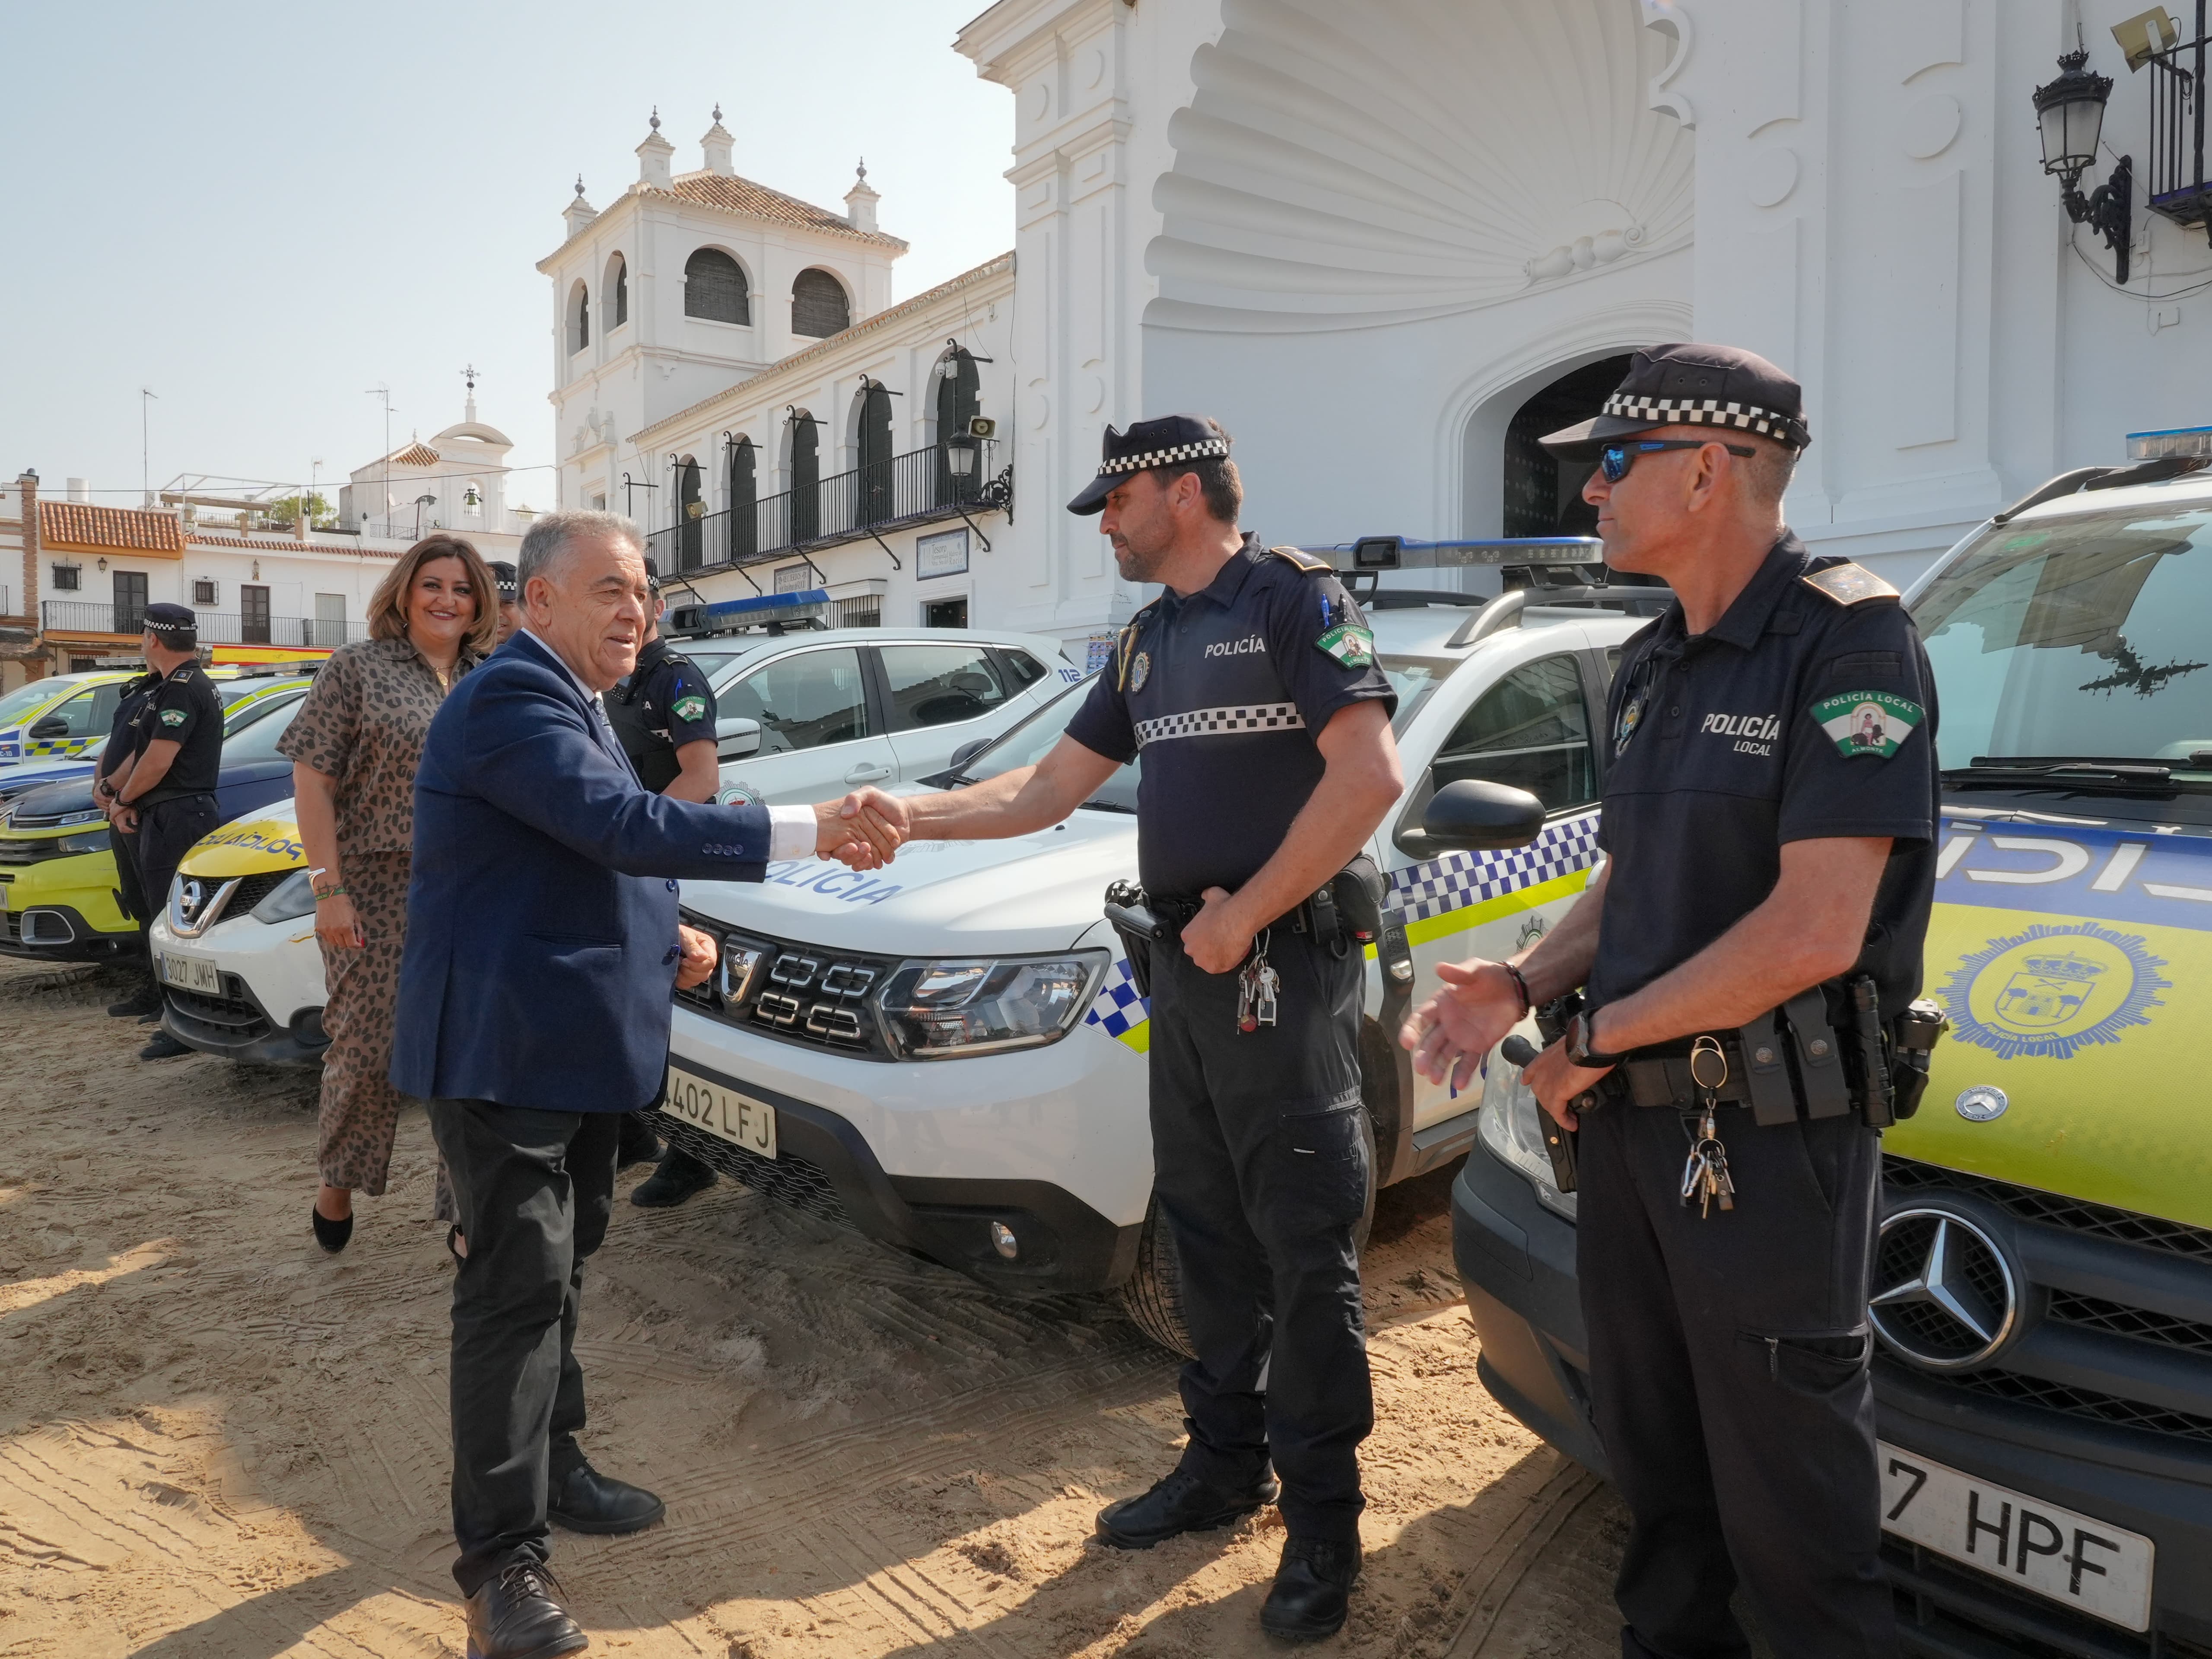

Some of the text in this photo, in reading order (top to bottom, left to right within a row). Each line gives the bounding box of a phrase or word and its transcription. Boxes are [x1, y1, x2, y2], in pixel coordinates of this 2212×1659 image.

[931, 544, 947, 554] Tesoro
[1205, 634, 1266, 659] POLICÍA
[1347, 658, 1370, 666] ALMONTE
[1058, 669, 1082, 682] 112
[1823, 692, 1913, 713] POLICÍA LOCAL
[1700, 713, 1780, 740] POLICÍA
[1733, 740, 1770, 756] LOCAL
[764, 861, 903, 905] OLICIA
[166, 957, 215, 989] 3027 JMH
[722, 1096, 768, 1148] LFJ
[1966, 1490, 2120, 1595] HPF
